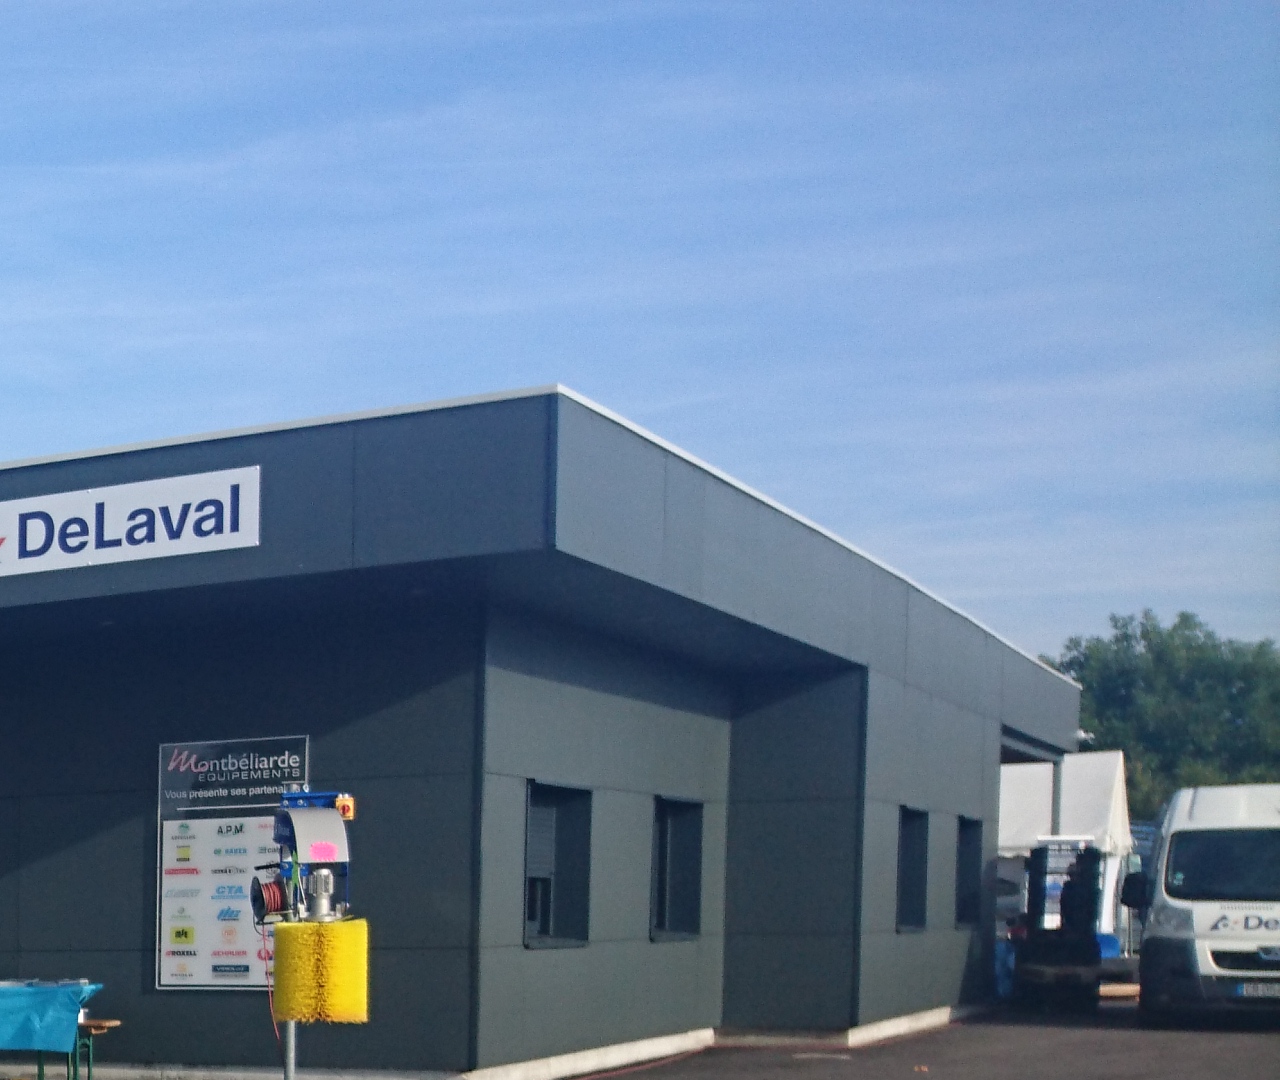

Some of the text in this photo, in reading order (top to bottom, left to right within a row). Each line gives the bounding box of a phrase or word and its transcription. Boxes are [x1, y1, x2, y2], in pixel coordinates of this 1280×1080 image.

[17, 483, 241, 560] DeLaval
[167, 747, 300, 773] Montbéliarde
[198, 768, 301, 782] EQUIPEMENTS
[165, 789, 187, 799] Vous
[189, 787, 229, 799] présente
[230, 787, 248, 796] ses
